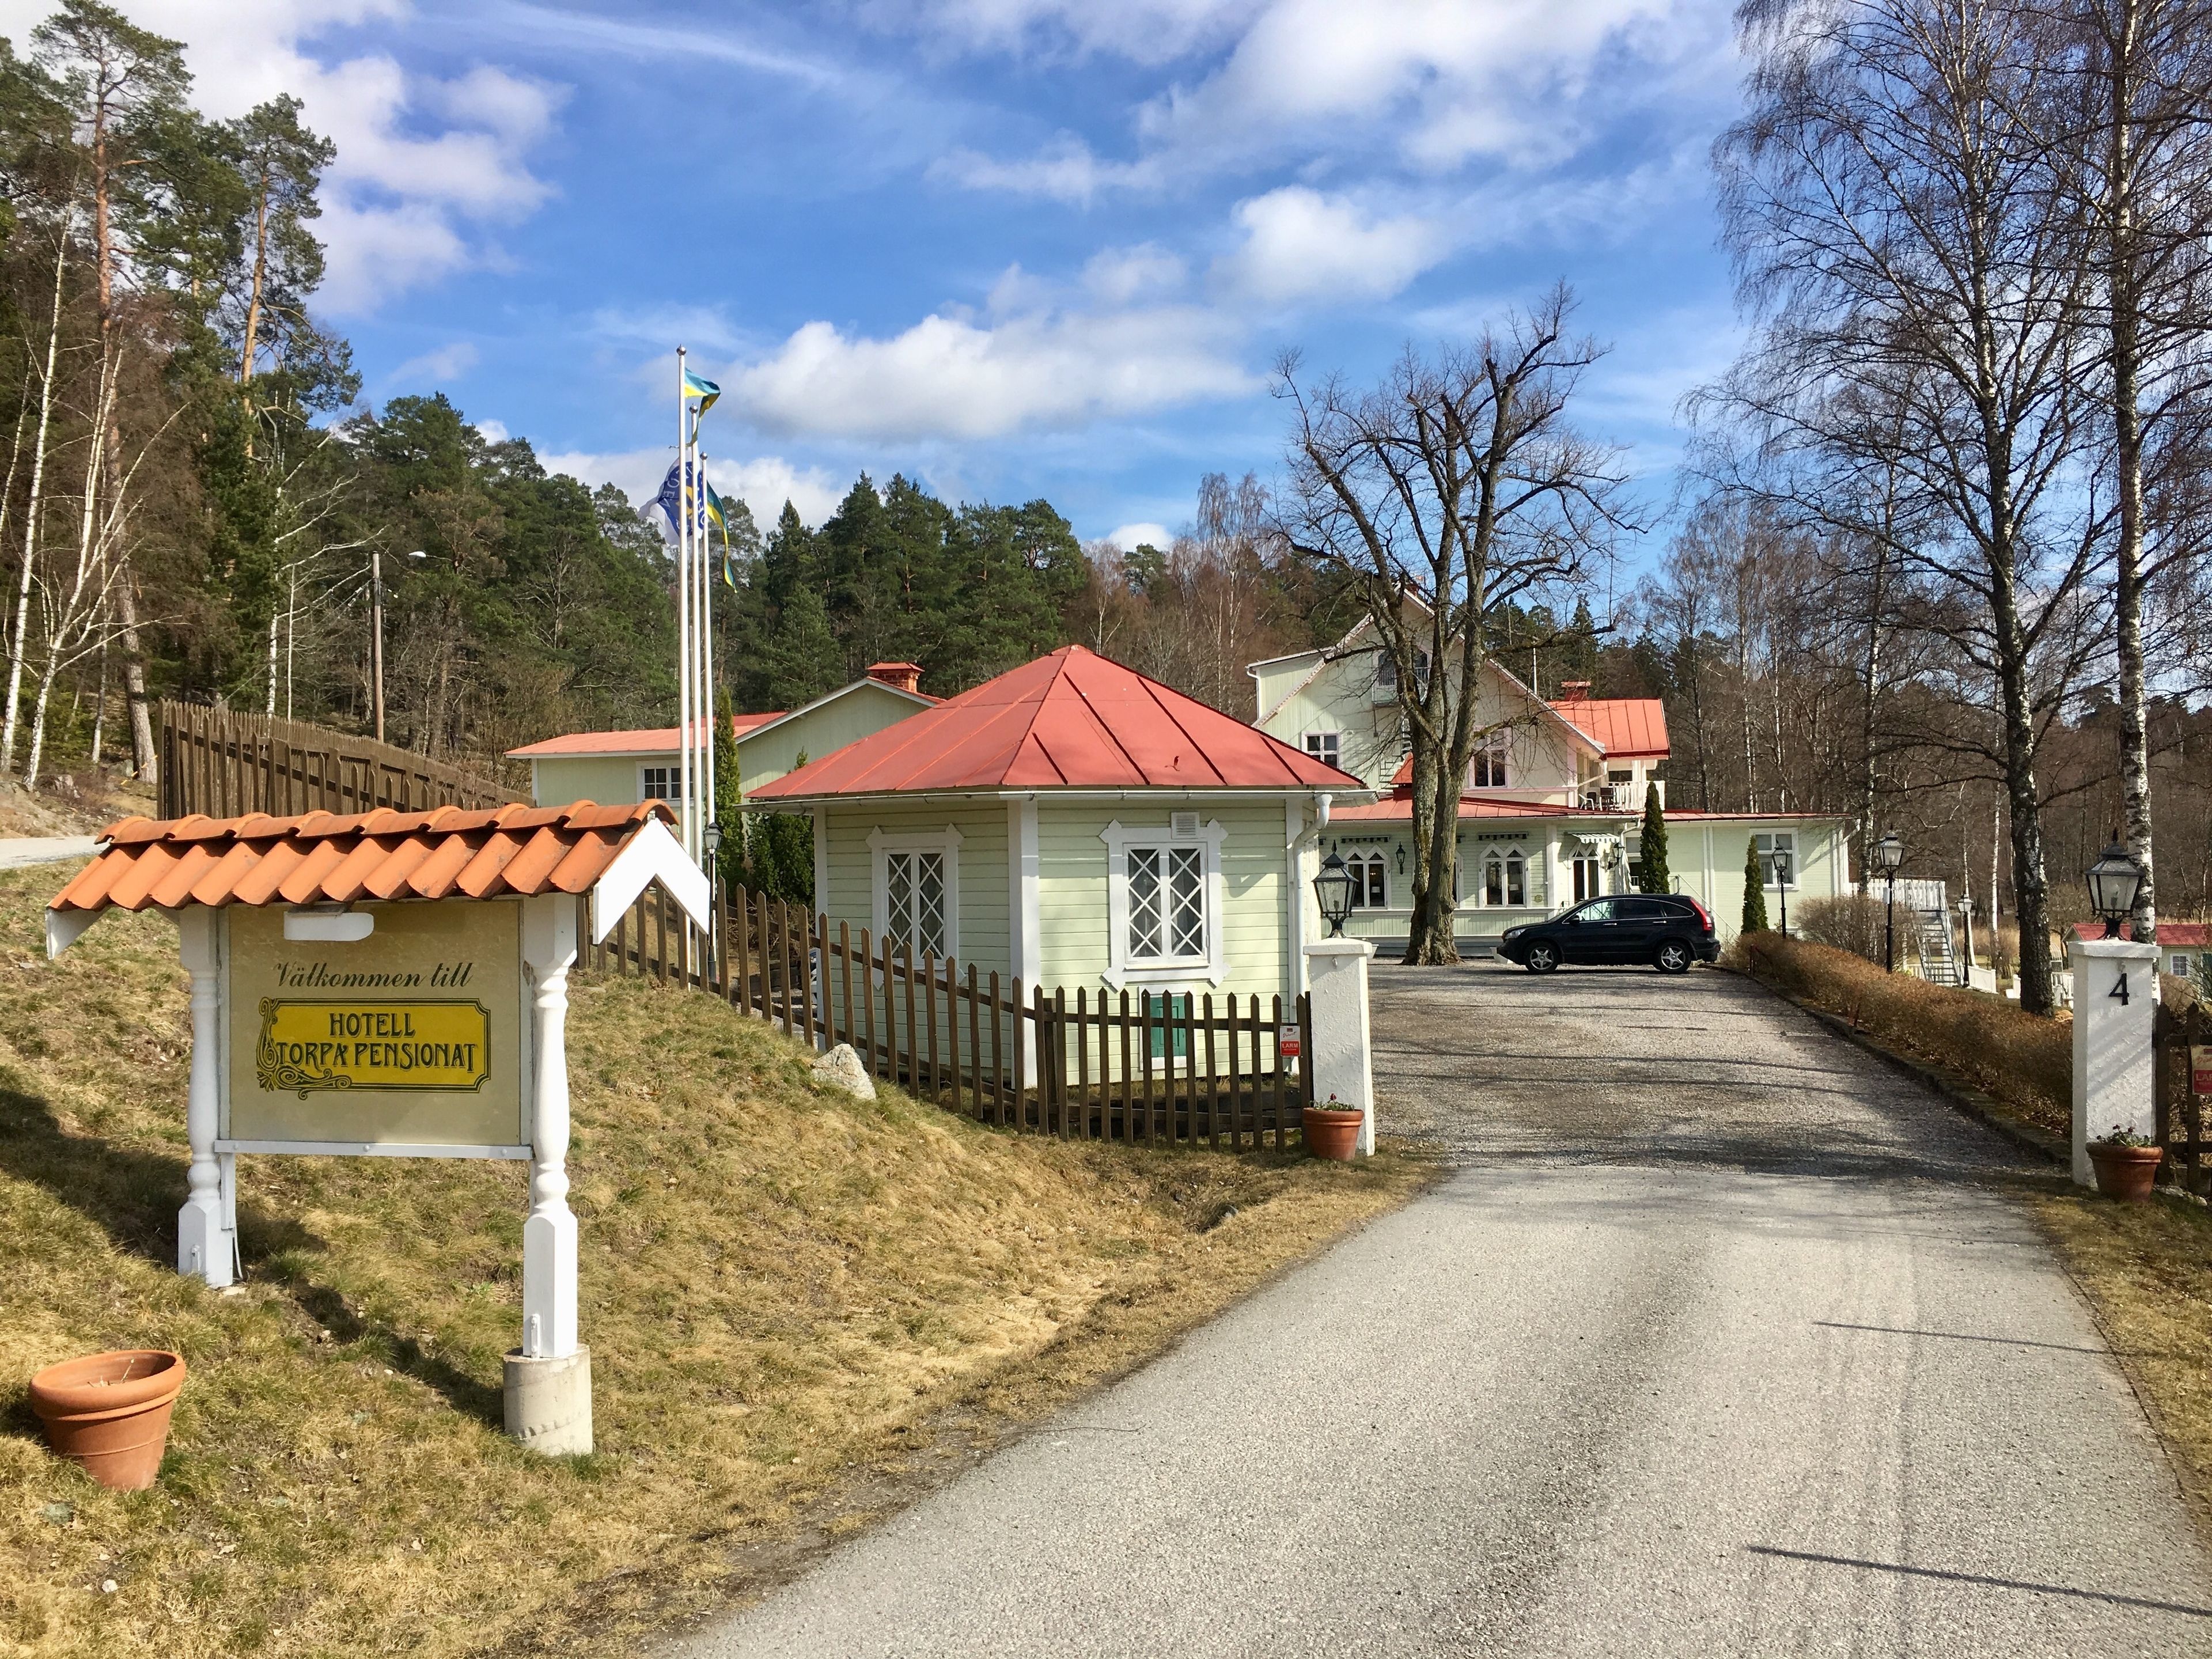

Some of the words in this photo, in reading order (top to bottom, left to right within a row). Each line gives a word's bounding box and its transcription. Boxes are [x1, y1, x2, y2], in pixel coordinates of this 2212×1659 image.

[272, 961, 425, 987] Välkommen
[429, 962, 474, 987] till
[2108, 973, 2130, 1006] 4
[329, 1013, 415, 1037] HOTELL
[276, 1042, 349, 1072] TORPA
[354, 1043, 478, 1073] PENSIONAT
